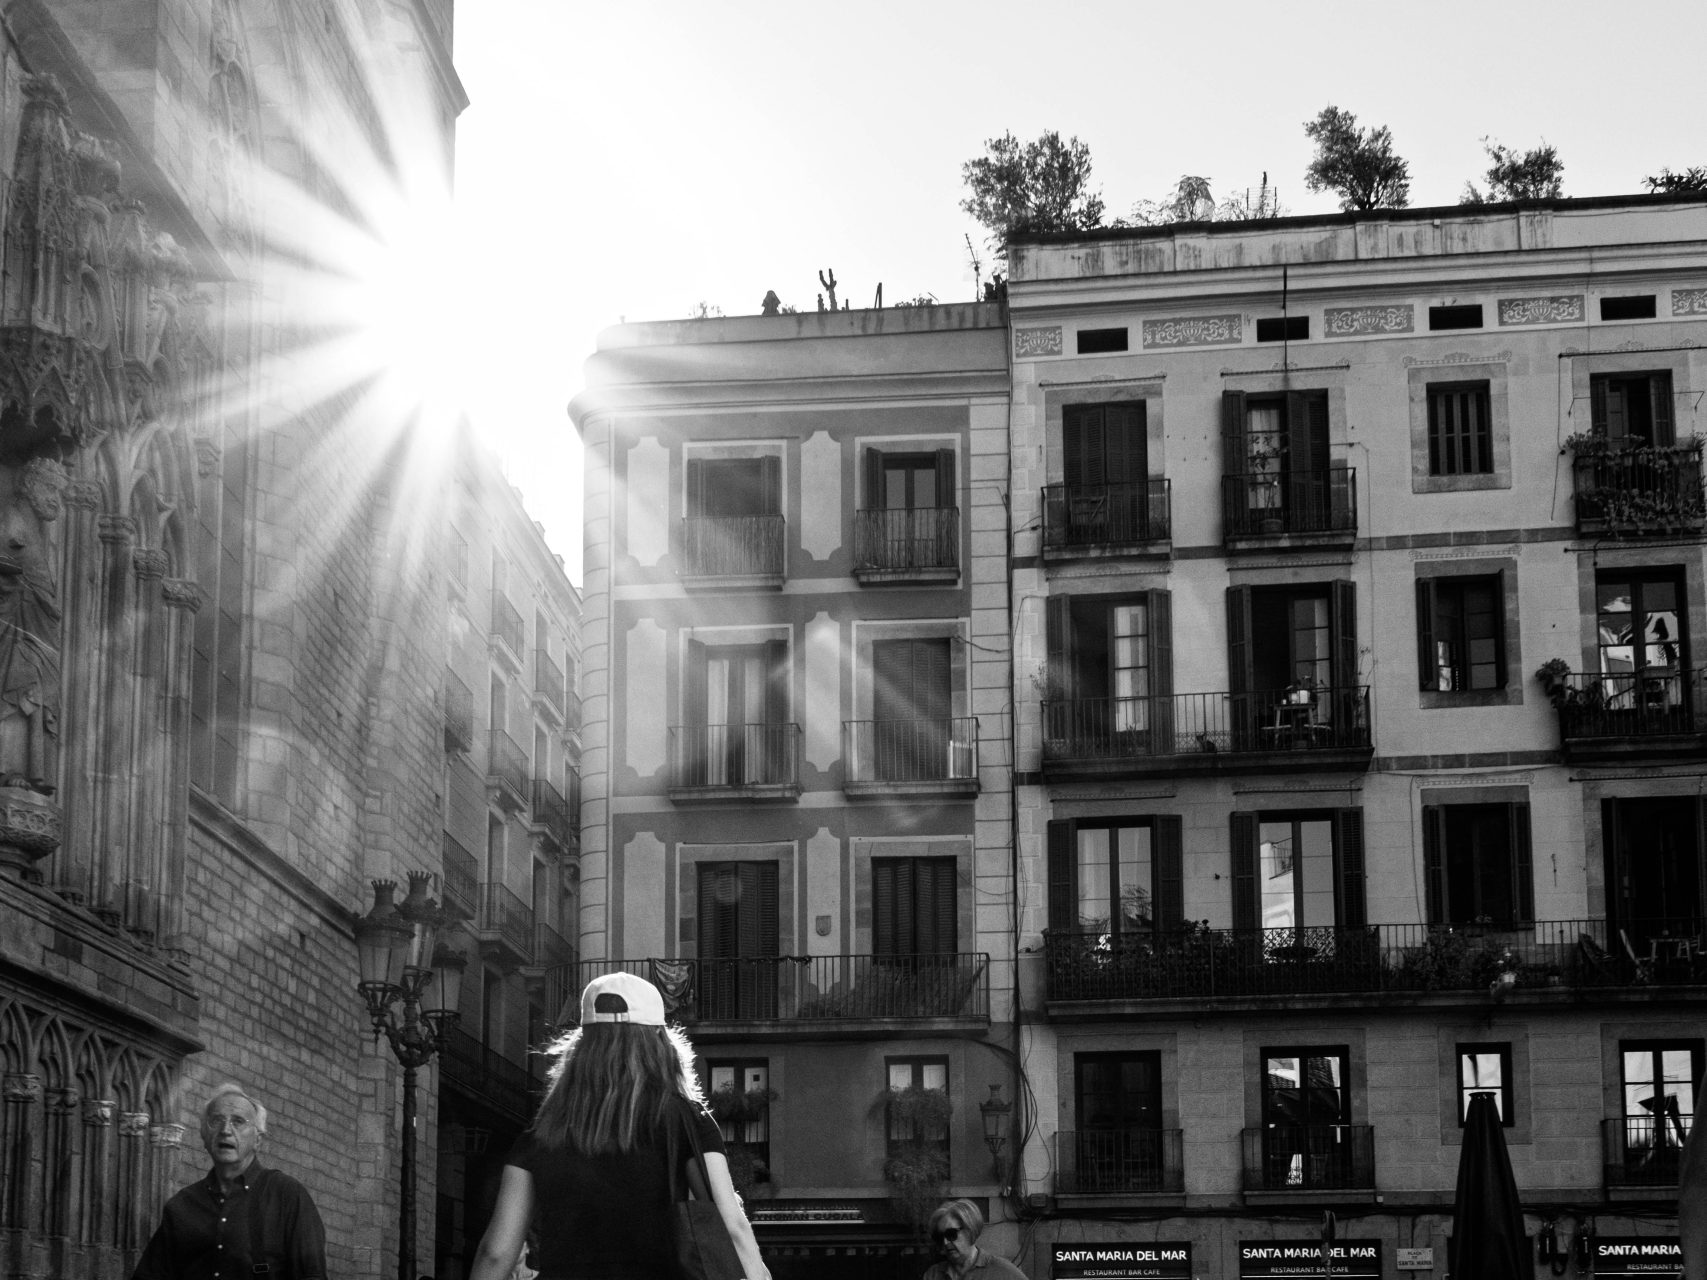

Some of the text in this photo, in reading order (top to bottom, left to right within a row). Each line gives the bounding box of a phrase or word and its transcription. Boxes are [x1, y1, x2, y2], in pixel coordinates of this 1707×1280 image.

[1055, 1250, 1187, 1262] SANTA MARIA DEL MAR
[1242, 1248, 1282, 1259] SANTA
[1284, 1247, 1322, 1258] MARIA
[1350, 1247, 1376, 1258] MAR
[1598, 1244, 1681, 1256] SANTA MARIA
